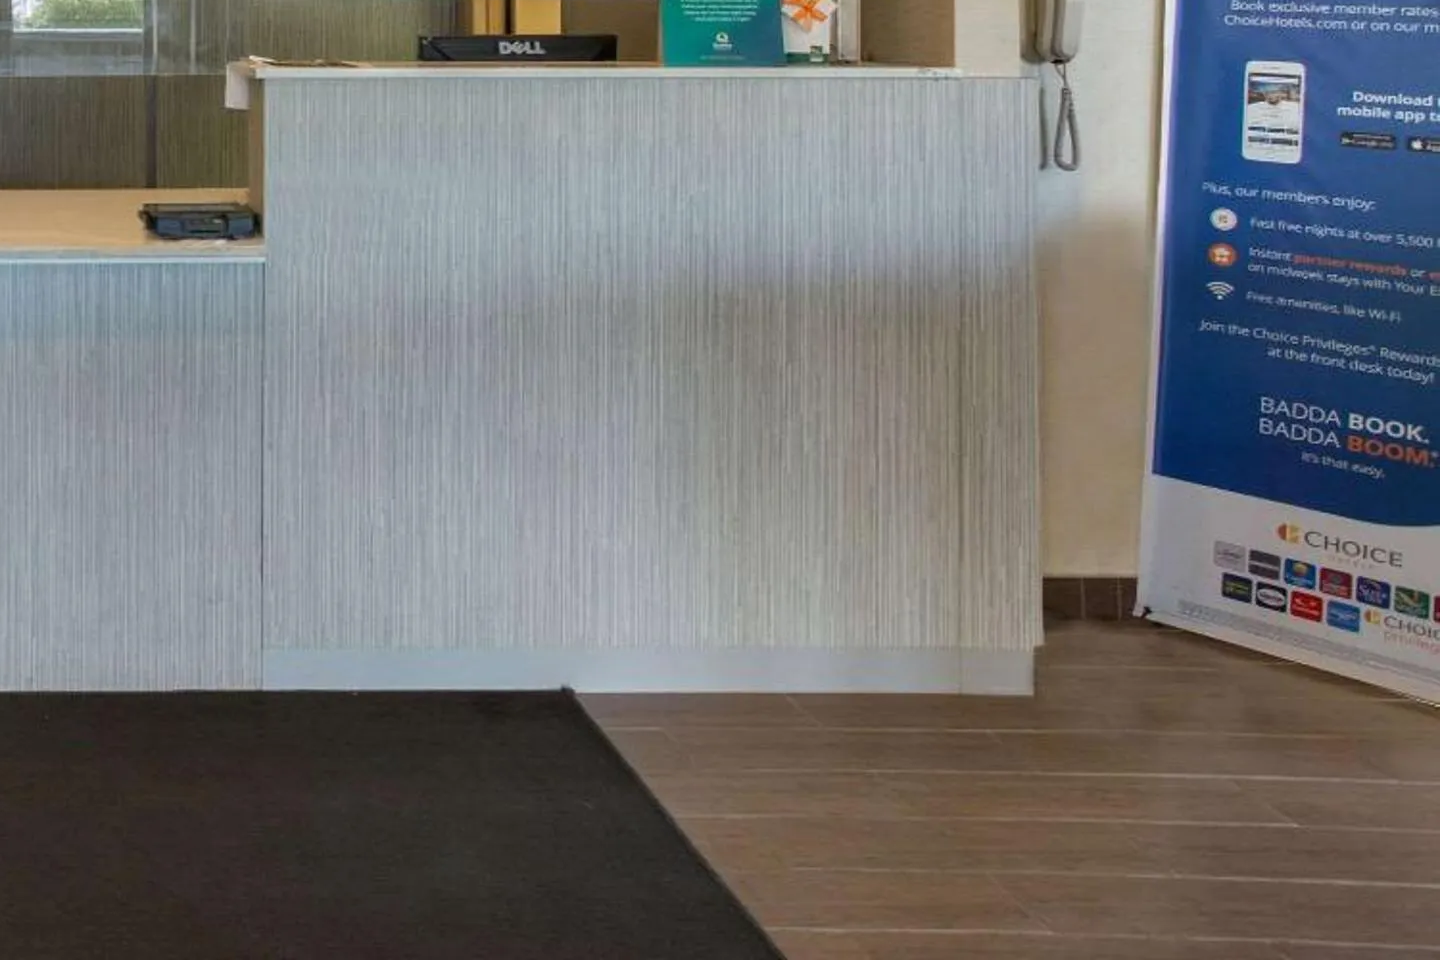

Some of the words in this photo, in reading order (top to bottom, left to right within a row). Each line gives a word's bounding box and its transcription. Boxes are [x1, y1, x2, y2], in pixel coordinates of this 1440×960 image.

[1230, 0, 1266, 11] Book
[1268, 1, 1330, 14] exclusive
[1334, 3, 1397, 16] member
[1223, 14, 1348, 30] ChoiceHotels.com
[1351, 21, 1367, 31] or
[1370, 22, 1390, 32] on
[1393, 23, 1421, 33] our
[498, 41, 547, 55] DELL
[1353, 91, 1433, 107] Download
[1337, 106, 1391, 118] mobile
[1394, 110, 1426, 124] app
[1202, 181, 1231, 196] Plus,
[1235, 187, 1257, 197] our
[1262, 189, 1331, 206] members
[1332, 197, 1377, 212] enjoy:
[1278, 221, 1303, 234] free
[1305, 224, 1345, 239] nights
[1347, 229, 1361, 239] at
[1362, 232, 1393, 243] over
[1248, 246, 1292, 261] Instant
[1411, 269, 1426, 279] or
[1248, 262, 1266, 273] on
[1326, 268, 1360, 287] stays
[1362, 274, 1391, 290] with
[1394, 280, 1425, 295] Your
[1343, 303, 1366, 319] like
[1368, 308, 1402, 324] Wi-Fi
[1199, 319, 1226, 335] Join
[1228, 322, 1250, 337] the
[1252, 326, 1299, 346] Choice
[1267, 347, 1282, 358] at
[1284, 348, 1308, 363] the
[1309, 352, 1347, 370] front
[1349, 358, 1384, 375] desk
[1387, 365, 1436, 386] today!
[1260, 396, 1341, 426] BADDA
[1348, 413, 1430, 443] BOOK.
[1259, 417, 1341, 448] BADDA
[1322, 454, 1350, 471] that
[1304, 530, 1404, 569] CHOICE
